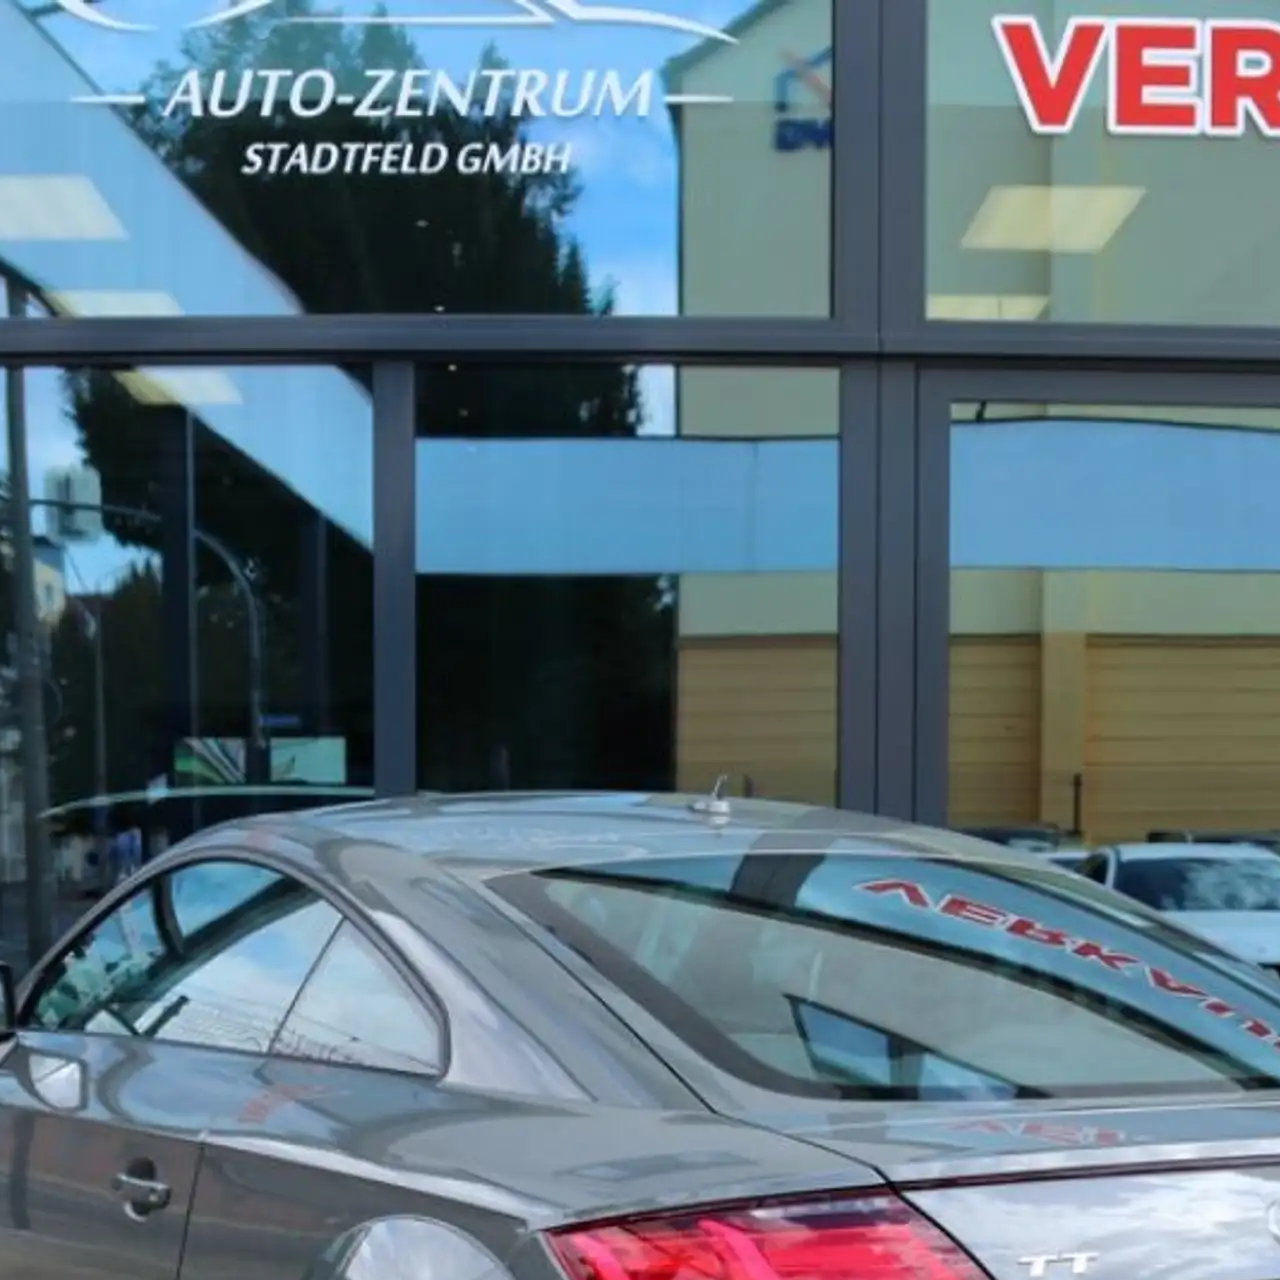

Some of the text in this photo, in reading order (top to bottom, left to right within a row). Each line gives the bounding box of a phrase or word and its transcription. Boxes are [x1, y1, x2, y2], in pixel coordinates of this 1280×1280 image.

[162, 69, 652, 118] AUTO-ZENTRUM
[242, 142, 572, 175] STADTFELD GMBH
[1017, 1251, 1100, 1277] TT
